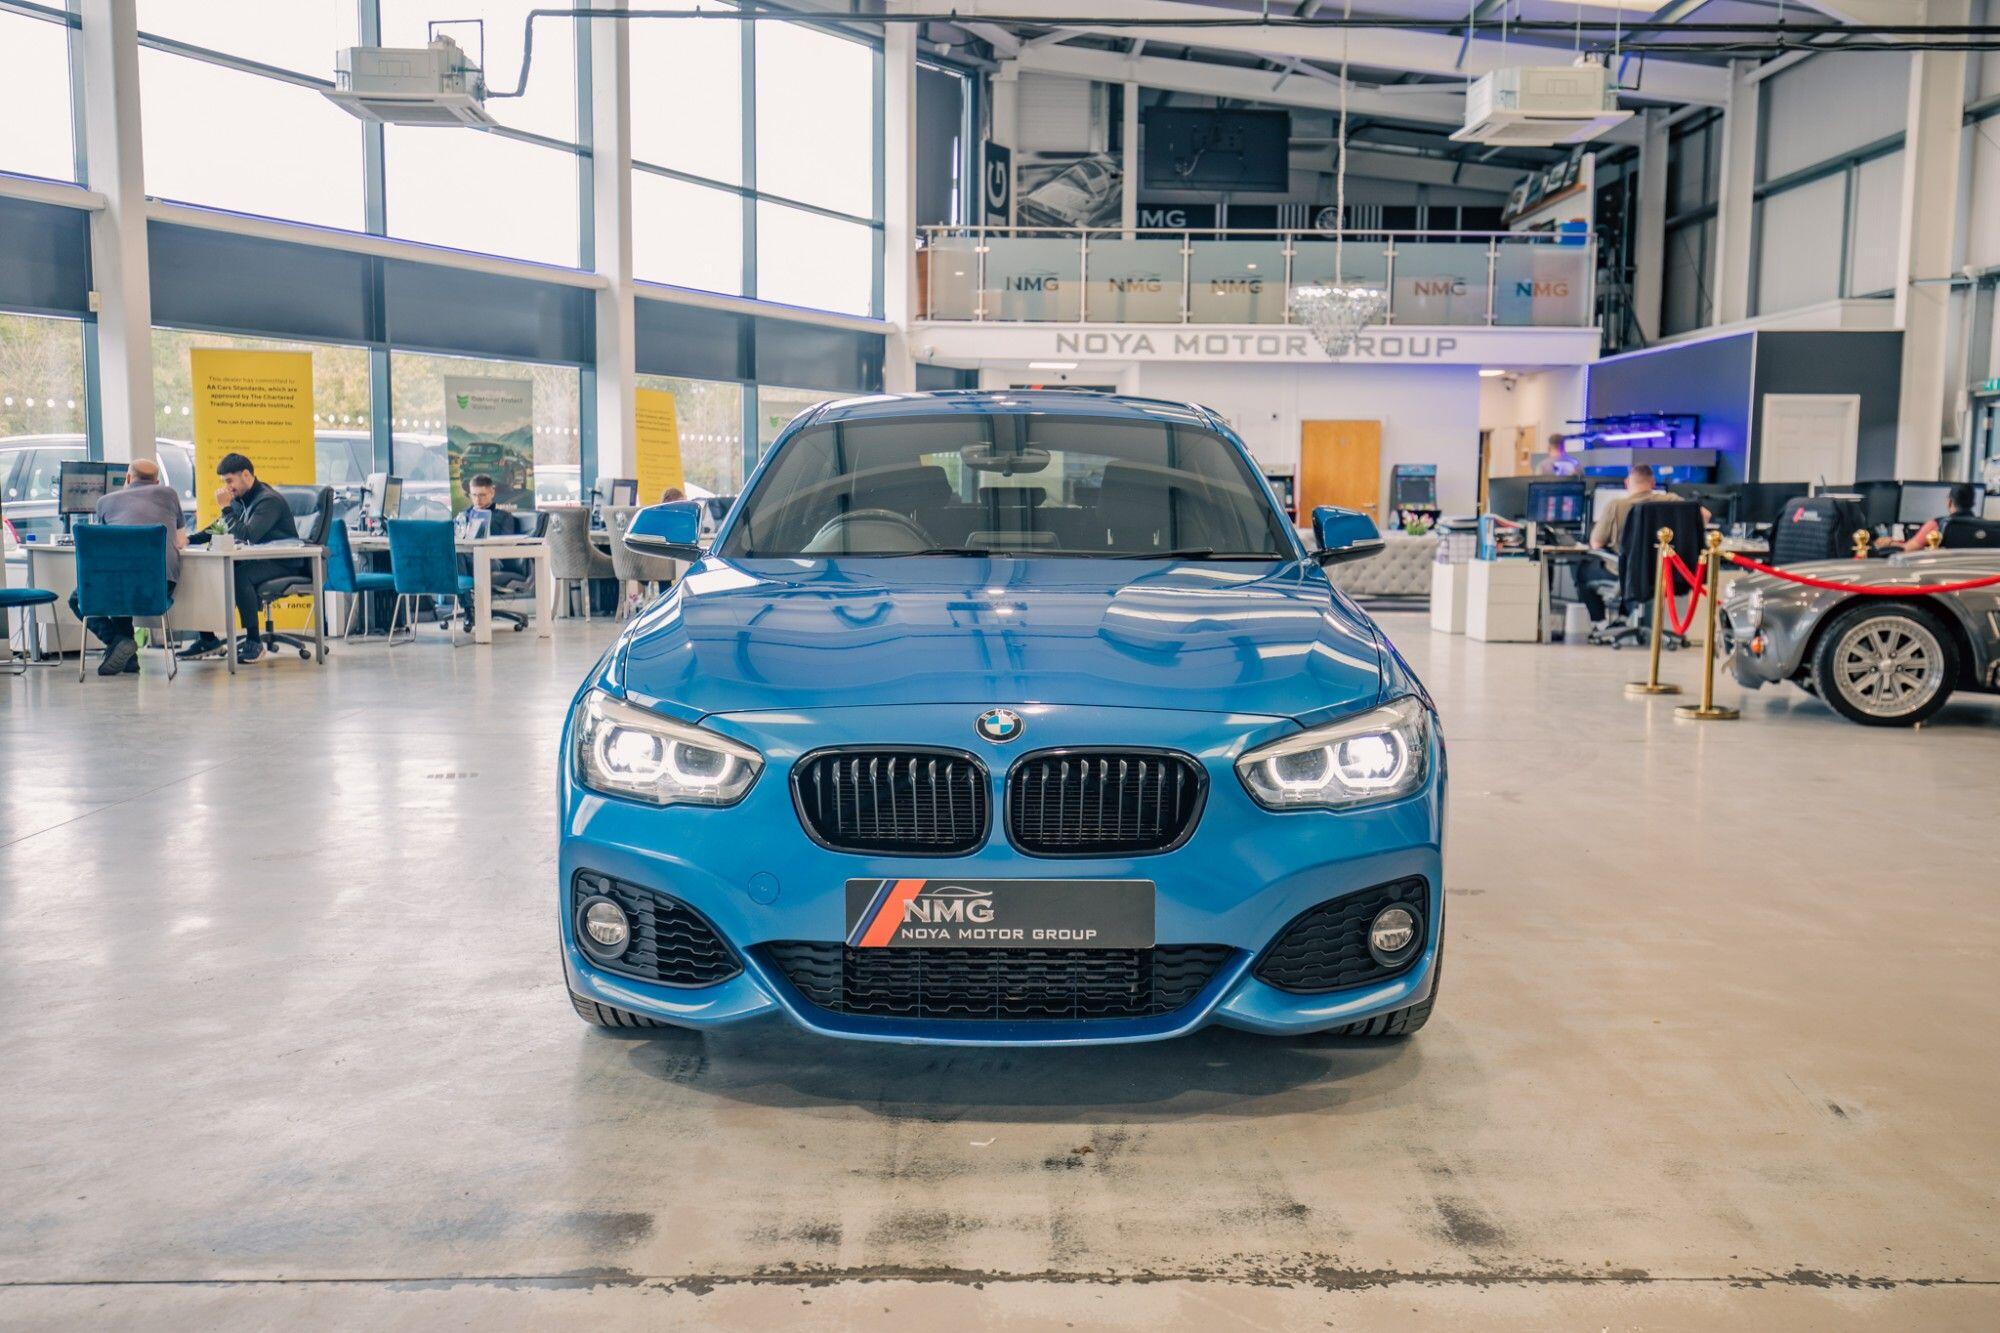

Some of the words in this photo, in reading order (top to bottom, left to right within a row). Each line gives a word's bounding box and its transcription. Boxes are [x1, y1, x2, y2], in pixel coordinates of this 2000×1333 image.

[1005, 276, 1060, 292] NMG
[1109, 277, 1162, 293] NMG
[1211, 278, 1264, 294] NMG
[1414, 280, 1467, 296] NMG
[1516, 282, 1569, 297] NMG
[1056, 333, 1155, 354] NOYA
[1175, 334, 1307, 356] MOTOR
[903, 899, 994, 923] NMG
[901, 928, 951, 940] NOYA
[959, 928, 1024, 940] MOTOR
[1032, 928, 1098, 941] GROUP
